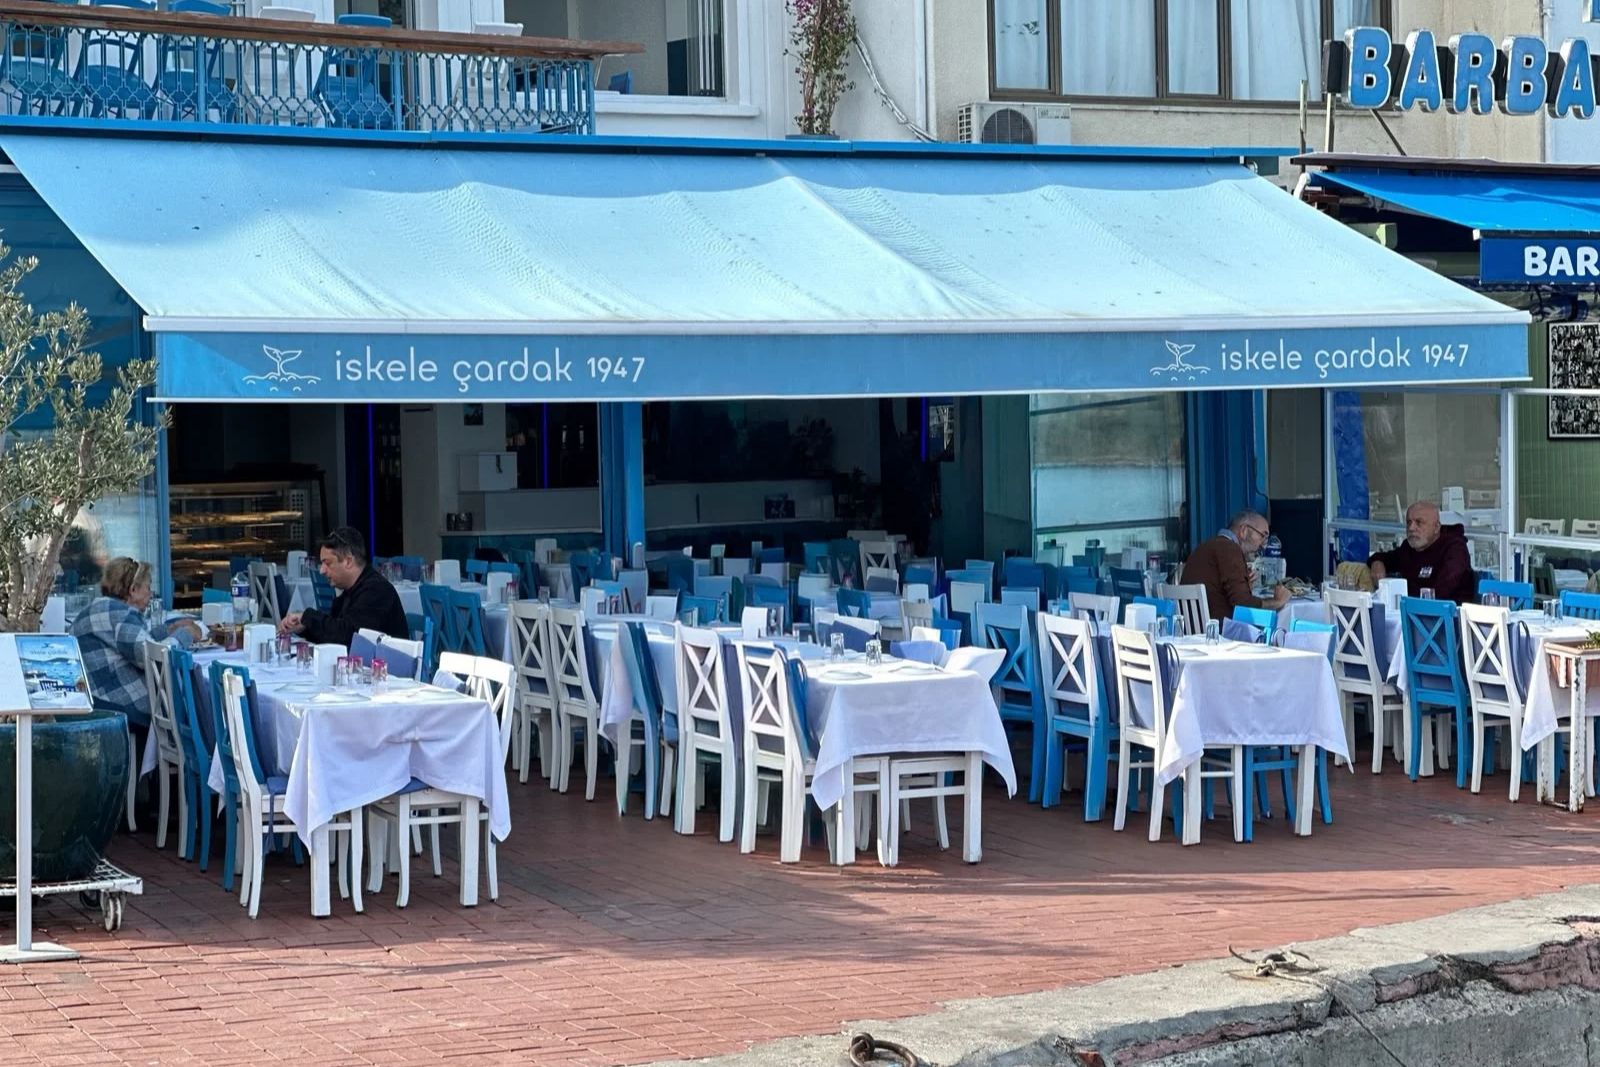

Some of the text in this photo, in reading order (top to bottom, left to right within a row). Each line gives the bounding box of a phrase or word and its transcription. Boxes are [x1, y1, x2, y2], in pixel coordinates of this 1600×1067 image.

[1345, 26, 1597, 119] BARBA
[1524, 245, 1600, 277] BAR
[335, 345, 645, 393] iskele çardak 1947
[1221, 335, 1469, 379] iskele çardak 1947
